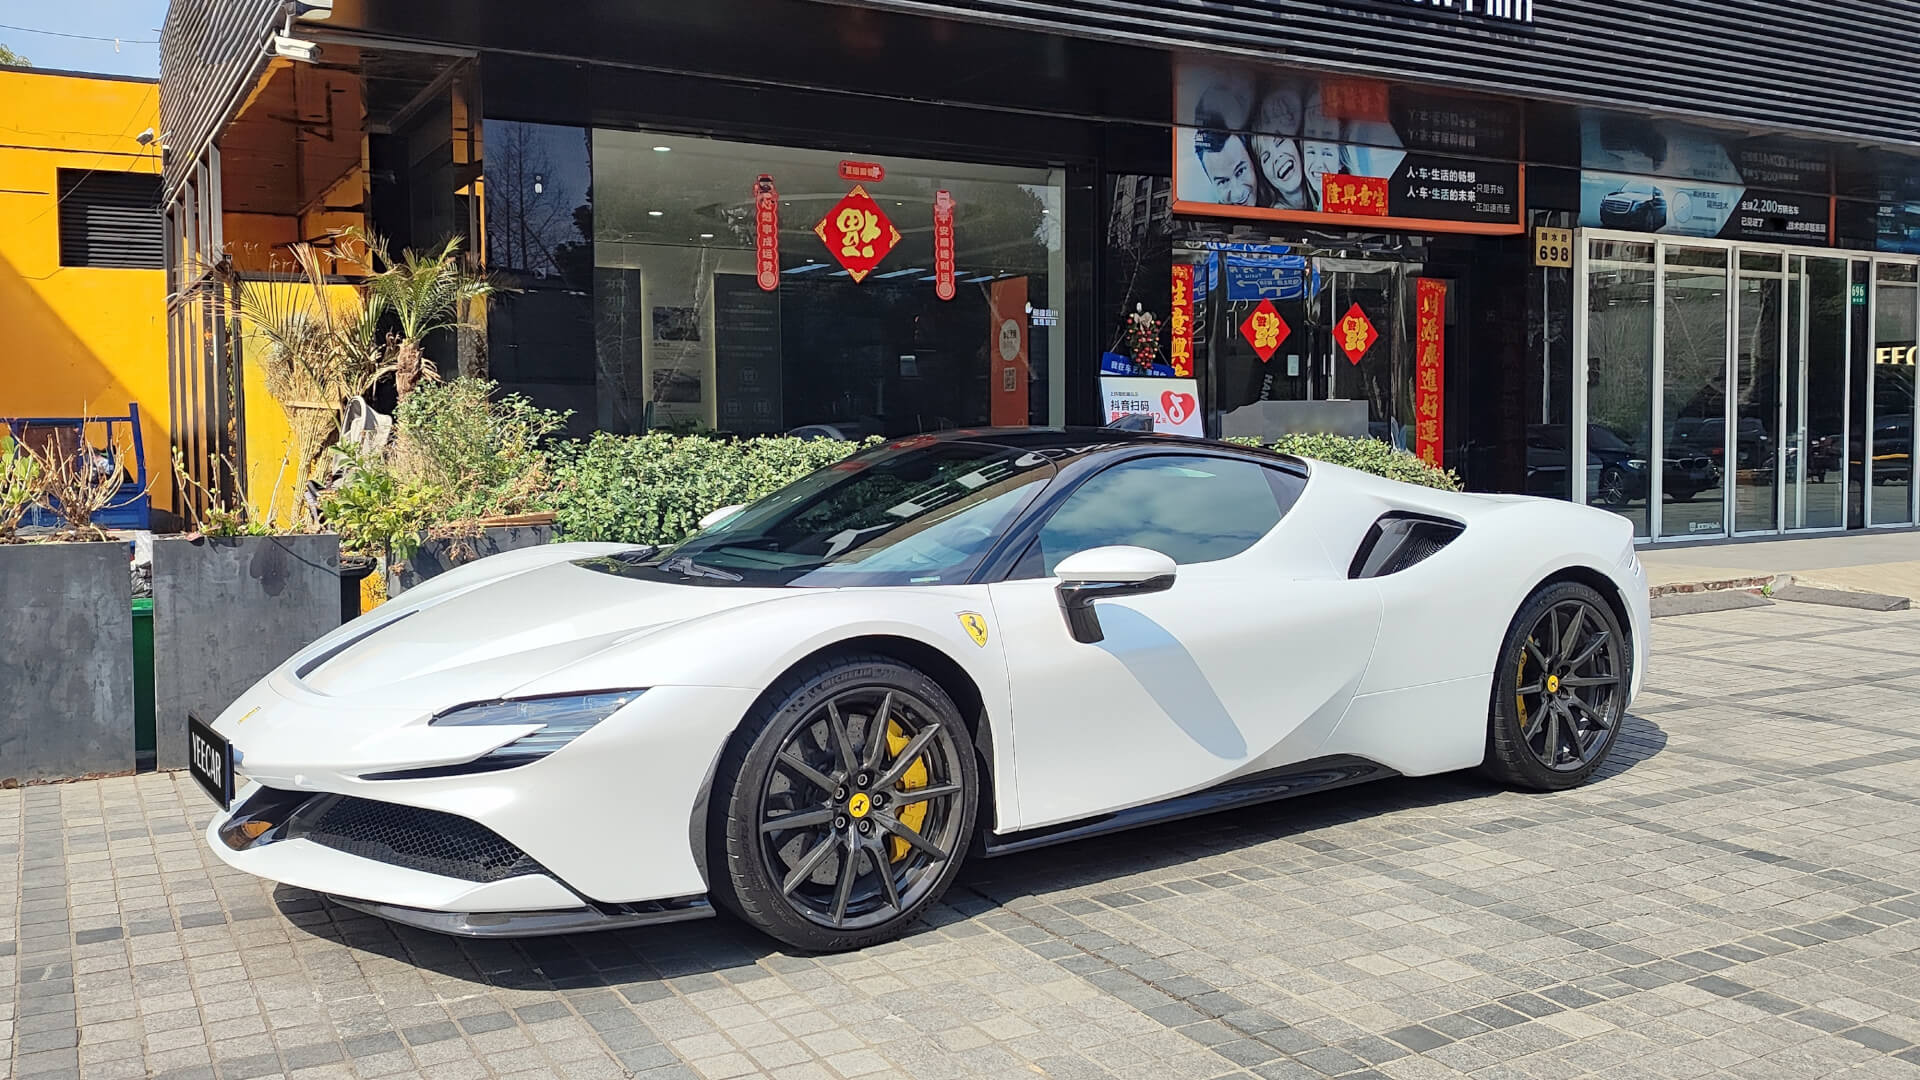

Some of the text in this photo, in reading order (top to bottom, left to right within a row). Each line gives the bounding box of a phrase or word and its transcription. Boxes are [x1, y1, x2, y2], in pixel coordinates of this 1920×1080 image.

[1406, 185, 1476, 202] 人·车·生活的未来
[836, 207, 882, 258] 福
[1539, 245, 1569, 262] 698
[1851, 286, 1865, 297] 696
[1251, 311, 1280, 349] 福
[1342, 315, 1369, 353] 福
[1110, 400, 1150, 411] 抖音扫码
[191, 731, 222, 789] YEECAR
